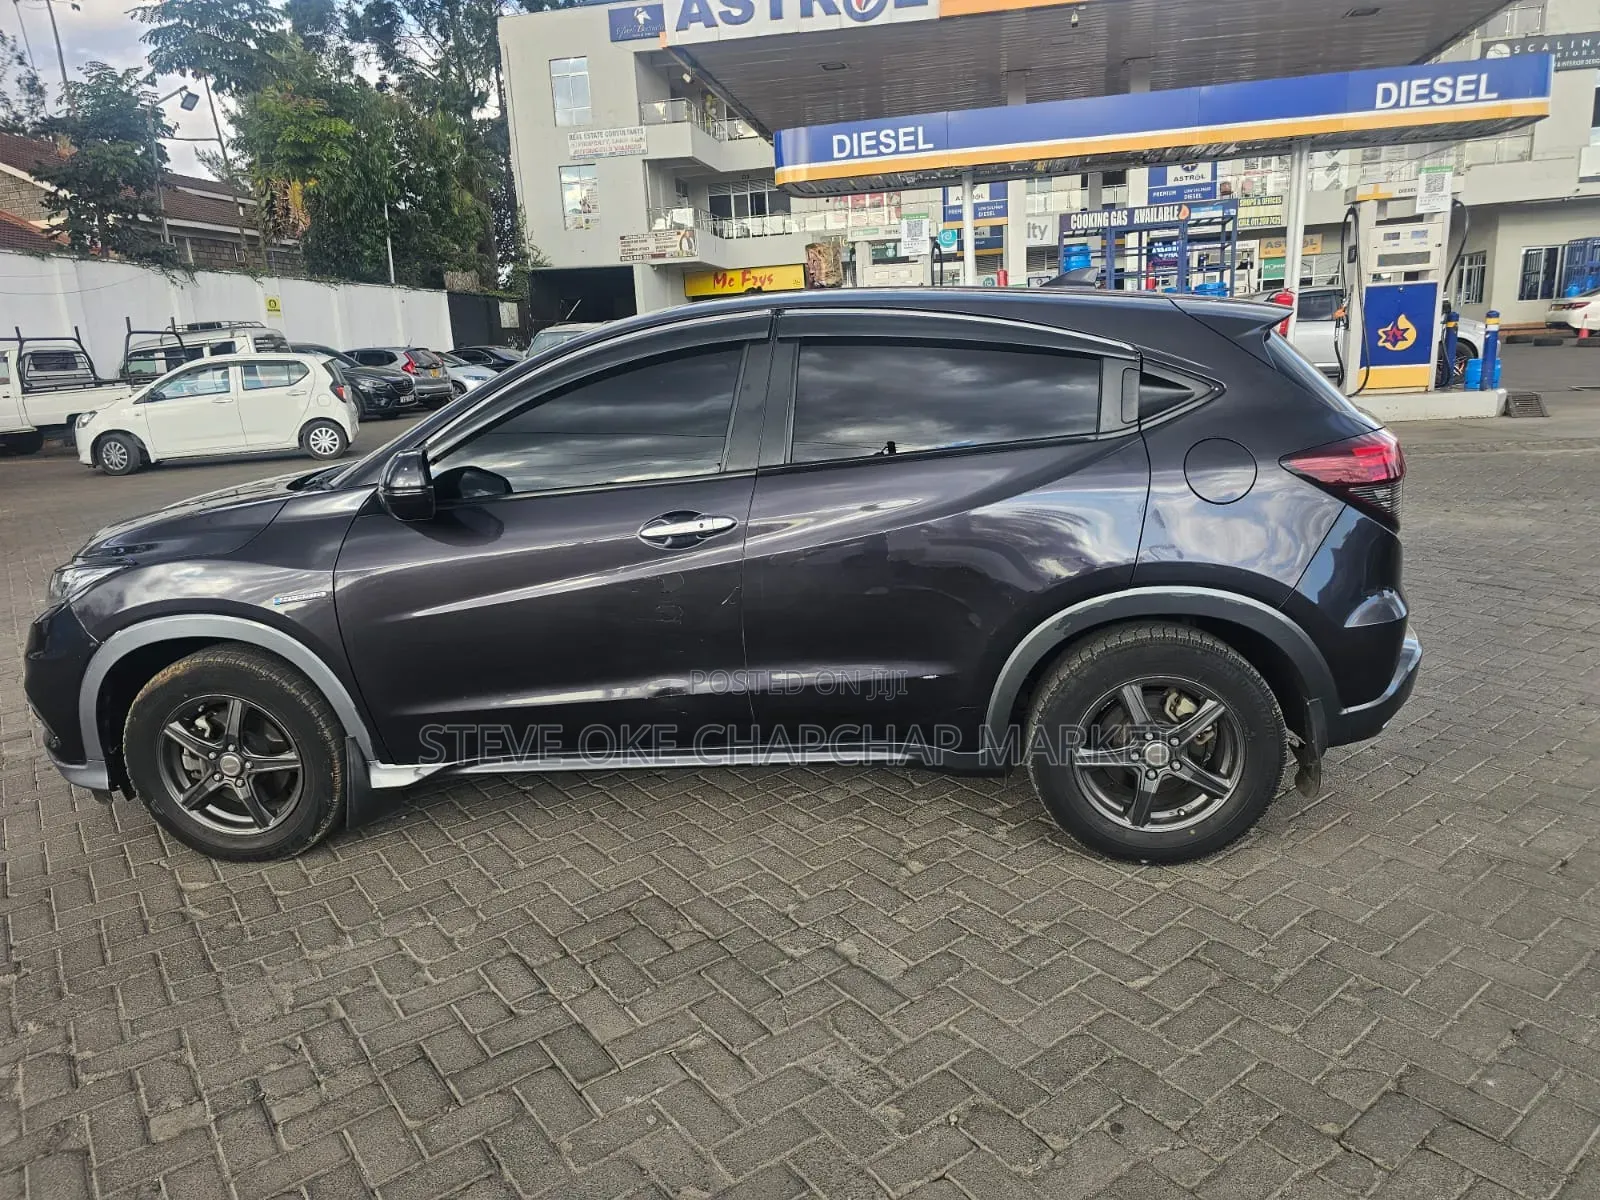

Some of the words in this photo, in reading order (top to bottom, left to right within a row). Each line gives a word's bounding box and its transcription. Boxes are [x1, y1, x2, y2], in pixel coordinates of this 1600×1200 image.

[676, 0, 928, 32] ASTRO
[1375, 73, 1498, 109] DIESEL
[832, 126, 934, 158] DIESEL
[1173, 174, 1206, 182] ASTROL
[1070, 211, 1109, 229] COOKING
[1110, 209, 1128, 227] GAS
[1133, 205, 1179, 225] AVAILABLE
